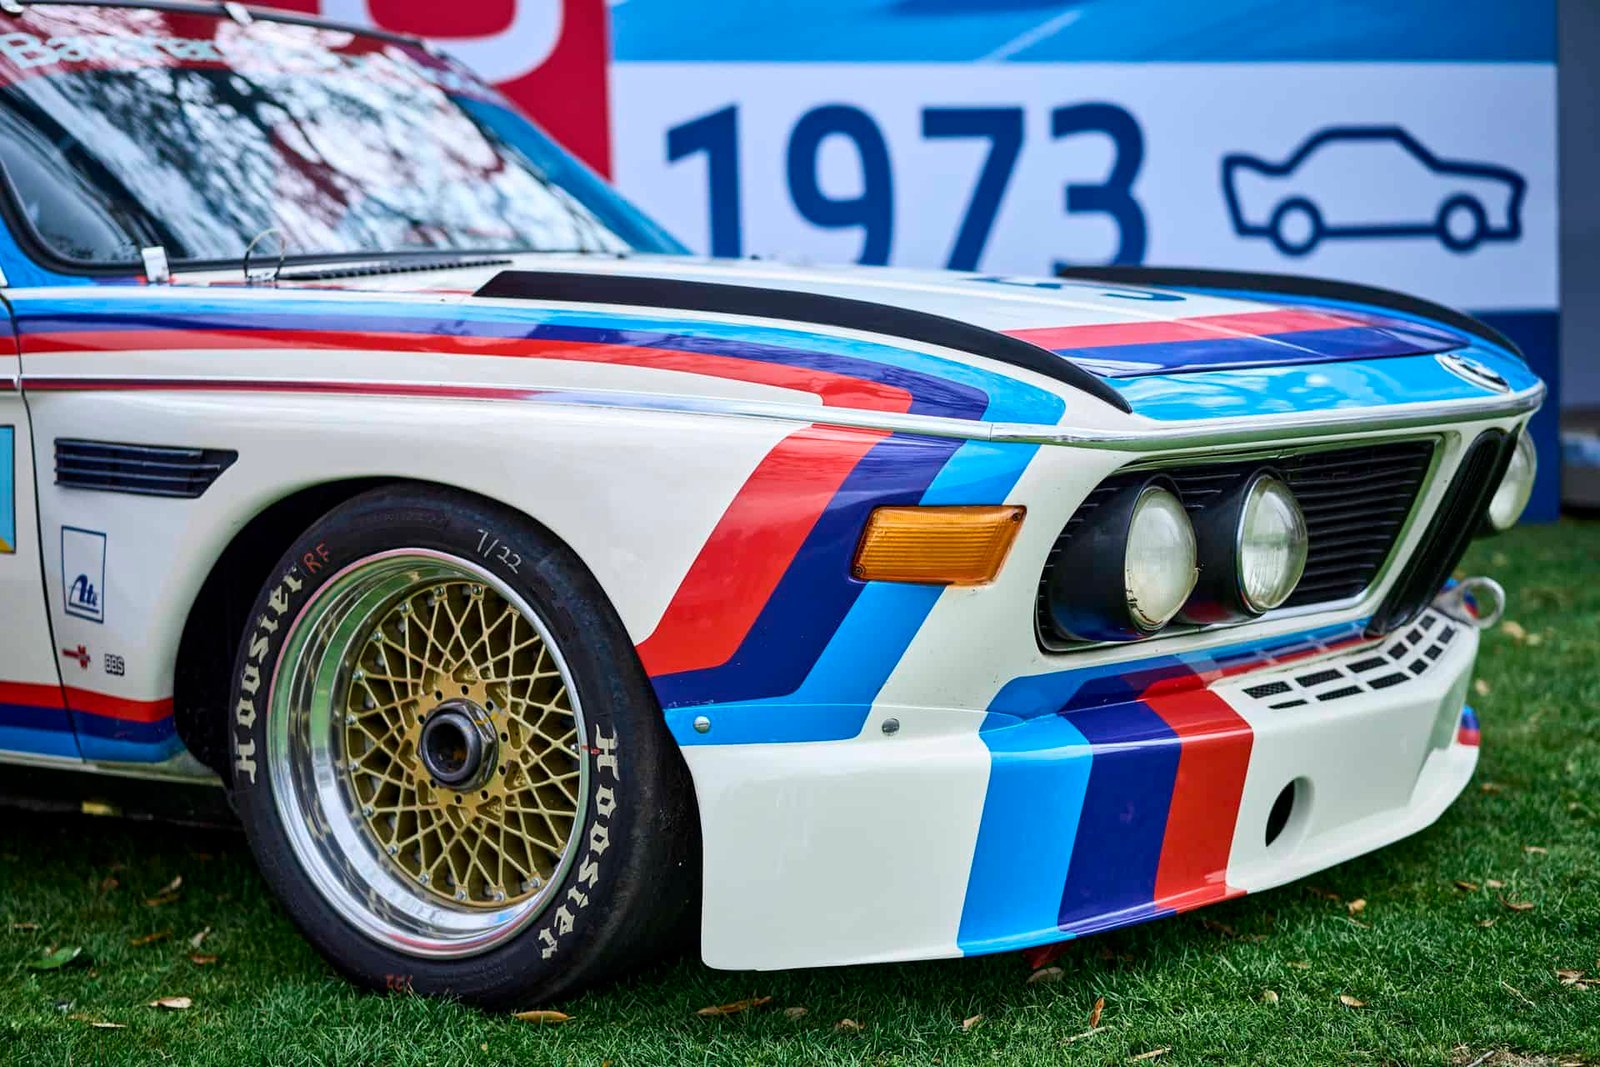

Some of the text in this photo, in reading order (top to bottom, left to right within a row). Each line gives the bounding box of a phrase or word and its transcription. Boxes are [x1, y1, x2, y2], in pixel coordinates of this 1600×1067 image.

[667, 102, 1147, 273] 1973
[303, 543, 330, 574] RF
[477, 528, 521, 574] 7/22
[105, 655, 125, 676] BBS
[233, 563, 302, 785] Hoosier
[538, 723, 620, 959] Hoosier
